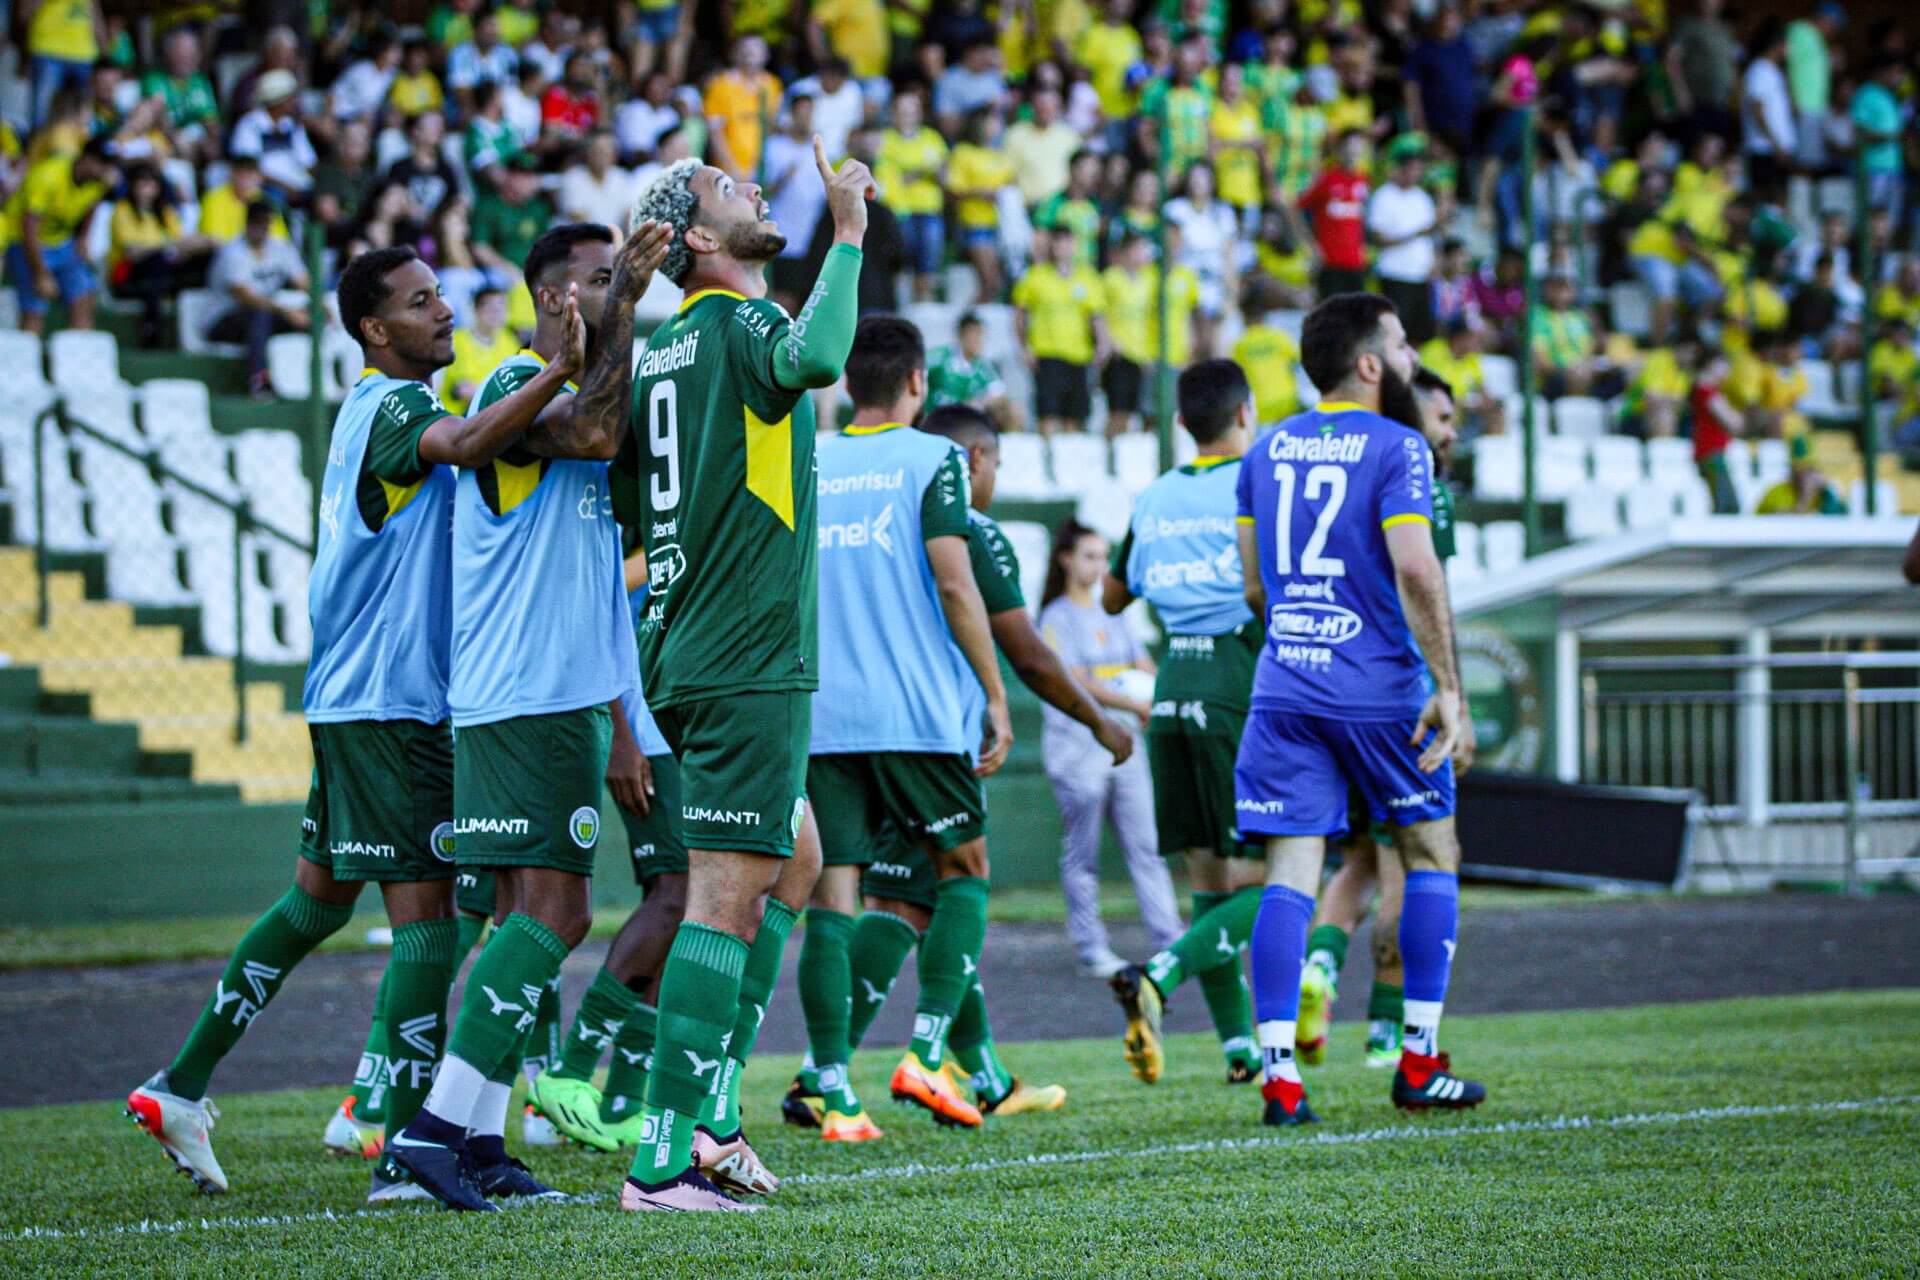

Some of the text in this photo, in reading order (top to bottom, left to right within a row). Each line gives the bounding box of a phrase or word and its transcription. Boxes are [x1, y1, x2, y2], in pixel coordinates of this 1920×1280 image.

[641, 329, 700, 378] avaletti
[648, 378, 681, 512] 9
[1269, 430, 1368, 463] Cavaletti
[817, 516, 869, 549] anel
[1273, 462, 1346, 577] 12
[1276, 643, 1332, 662] MAYER
